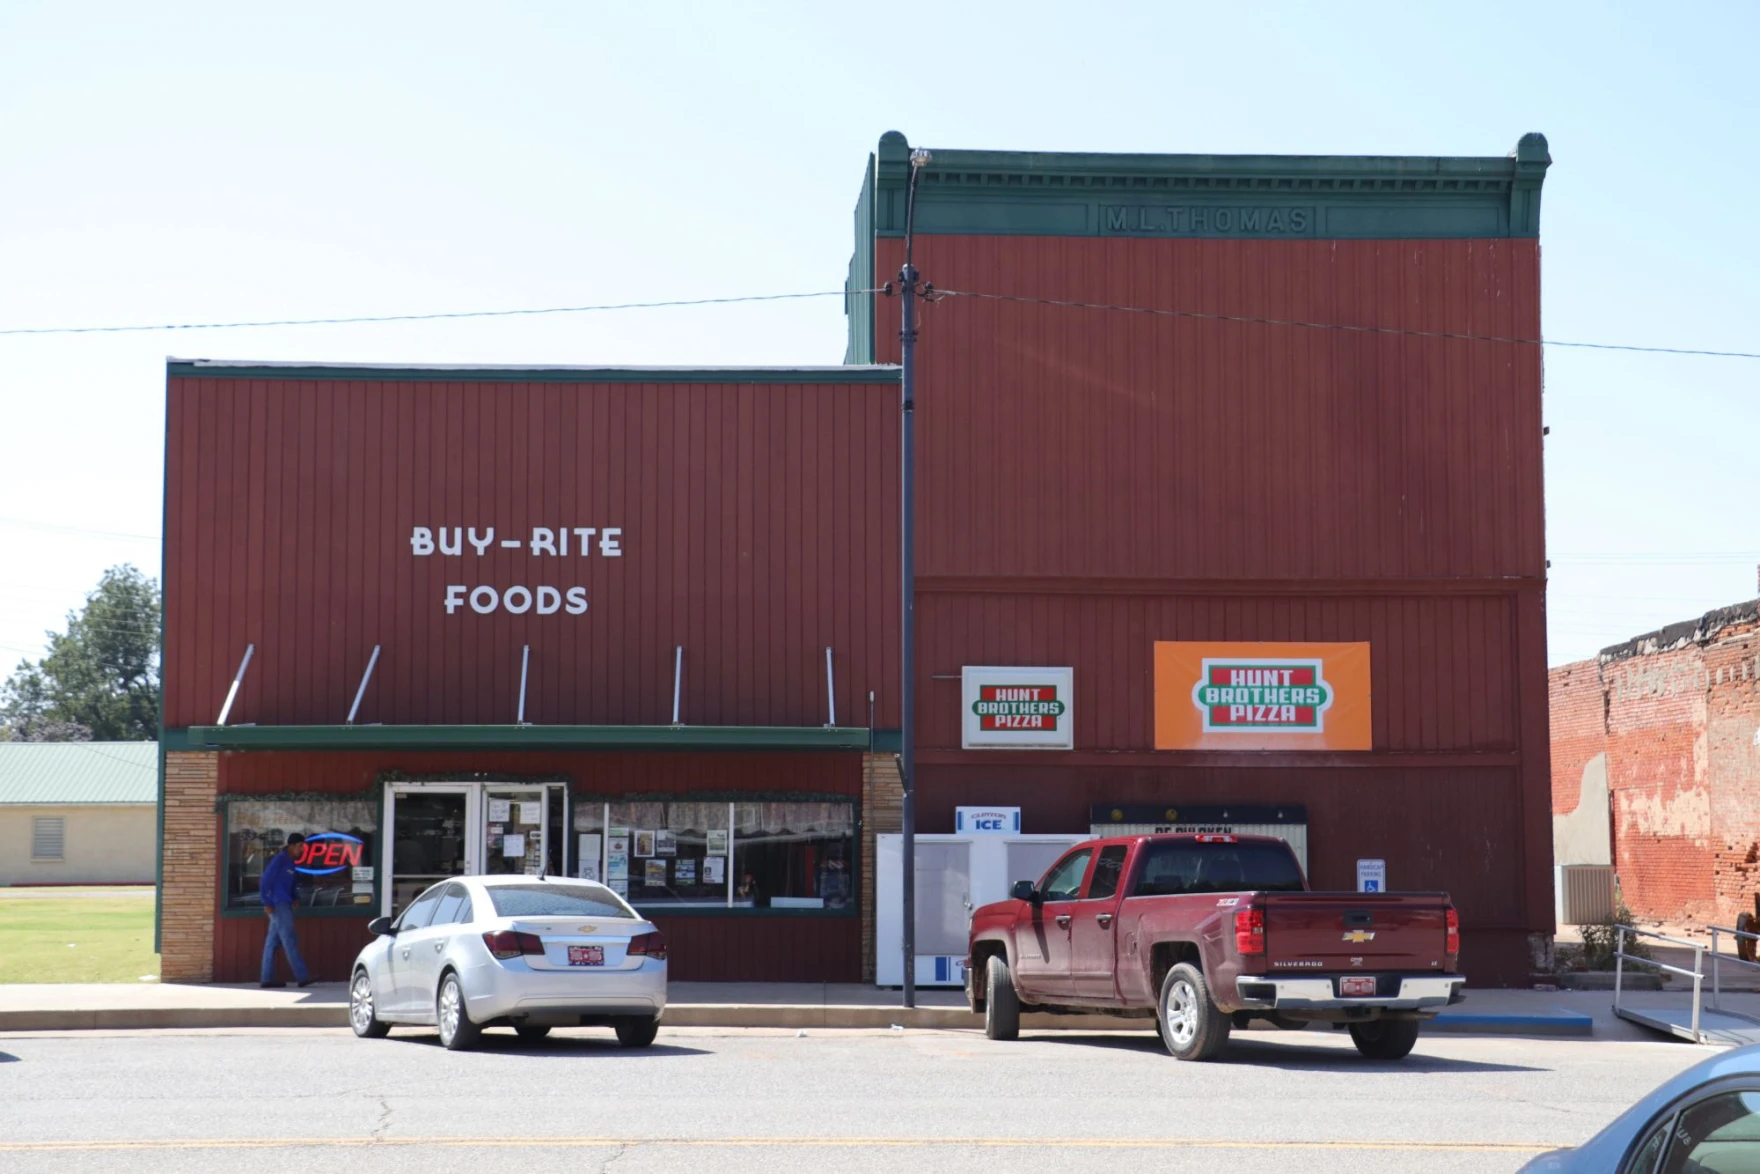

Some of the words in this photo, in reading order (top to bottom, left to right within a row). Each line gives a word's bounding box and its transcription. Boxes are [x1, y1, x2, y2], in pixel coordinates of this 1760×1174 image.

[410, 526, 622, 557] BUY-RITE
[444, 585, 588, 615] FOODS
[1230, 669, 1294, 687] HUNT
[995, 688, 1041, 701] HUNT
[1205, 687, 1320, 704] BROTHERS
[977, 702, 1060, 714] BROTHERS
[1230, 704, 1296, 722] PIZZA
[995, 715, 1042, 727] PIZZA
[975, 819, 1003, 830] ICE
